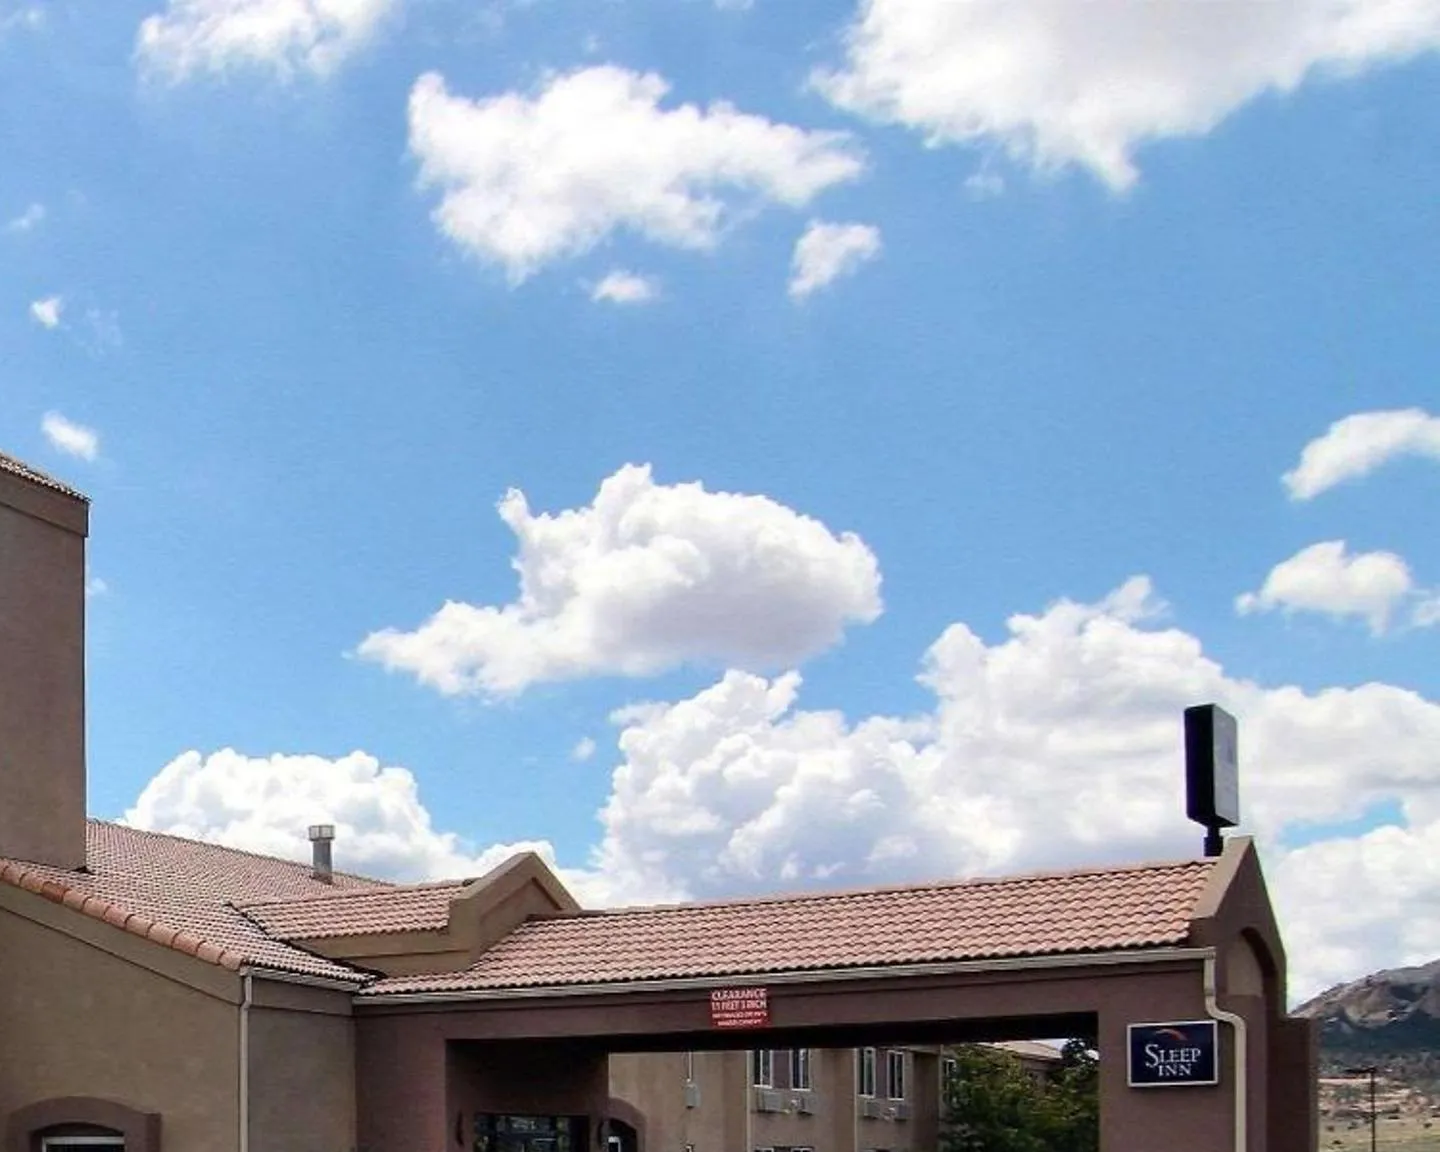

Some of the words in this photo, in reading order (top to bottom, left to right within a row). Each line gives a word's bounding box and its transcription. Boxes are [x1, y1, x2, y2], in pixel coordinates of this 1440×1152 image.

[711, 988, 767, 1001] CLEARANCE
[1144, 1043, 1202, 1069] SLEEP
[1158, 1063, 1193, 1077] INN
